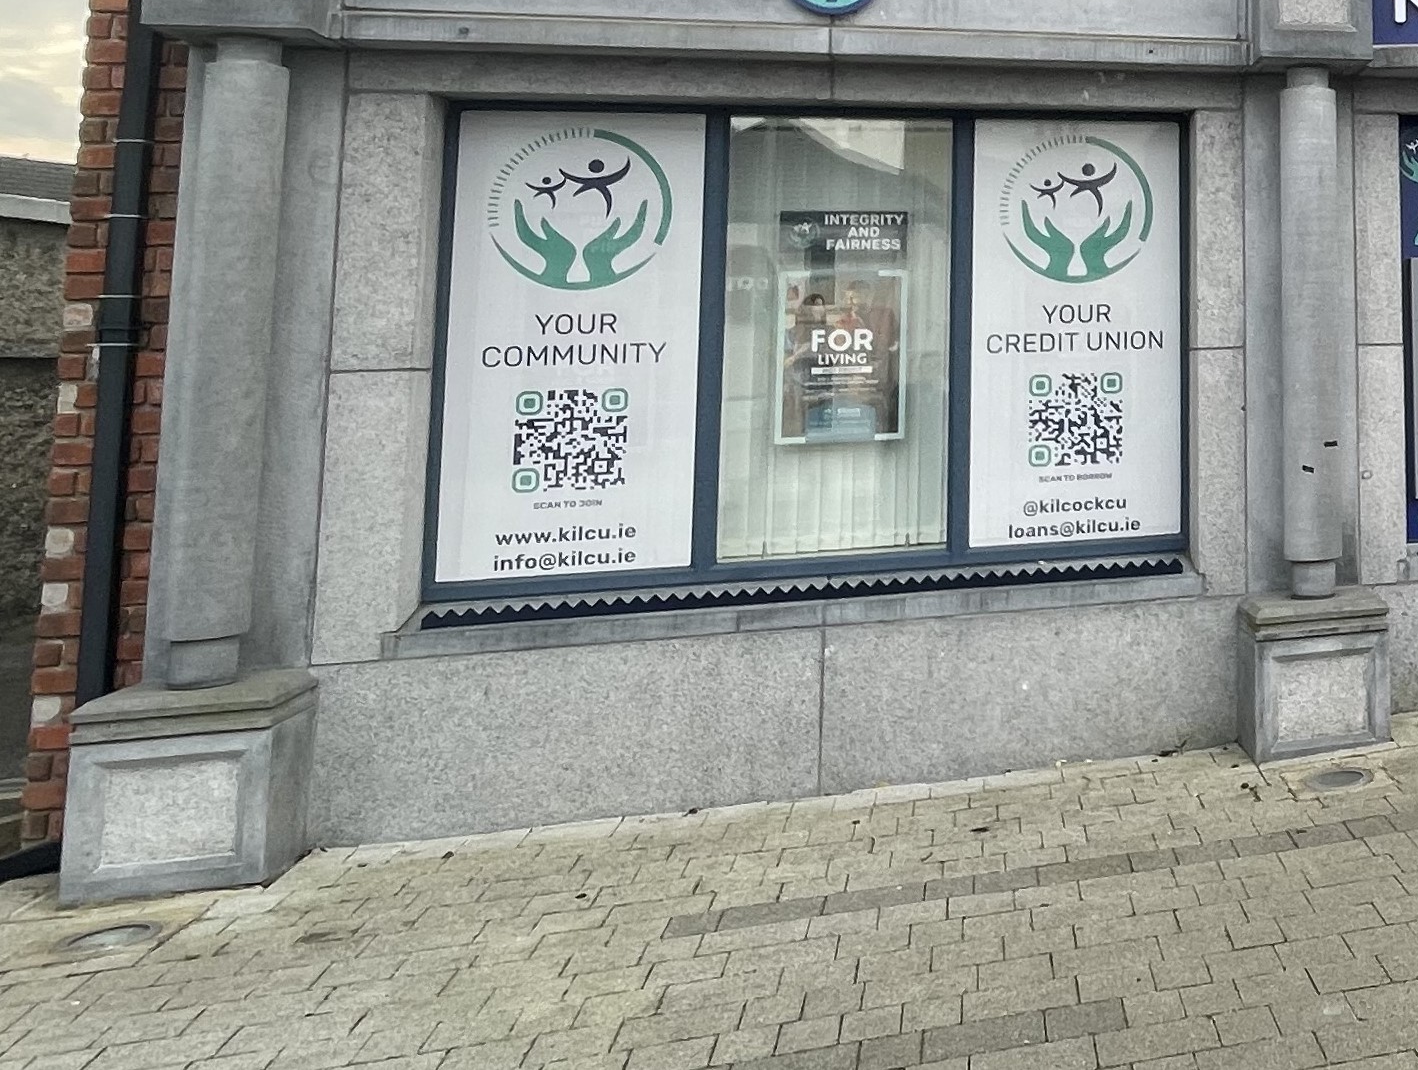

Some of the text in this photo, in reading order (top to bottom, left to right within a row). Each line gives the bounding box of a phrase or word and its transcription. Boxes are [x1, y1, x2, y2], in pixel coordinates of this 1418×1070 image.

[824, 214, 903, 226] INTEGRITY
[847, 226, 880, 238] AND
[826, 238, 901, 250] FAIRNESS
[535, 313, 618, 335] YOUR
[1042, 303, 1112, 324] YOUR
[811, 328, 874, 353] FOR
[986, 330, 1164, 354] CREDIT UNION
[482, 341, 667, 368] COMMUNITY
[818, 352, 868, 365] LIVING
[533, 500, 561, 510] SCAN
[563, 500, 577, 509] TO
[1023, 496, 1127, 516] @kilcockcu
[495, 523, 637, 546] www.kilcu.ie
[1008, 517, 1141, 539] loans@kilcu.ie
[493, 548, 636, 571] info@kilcu.ie
